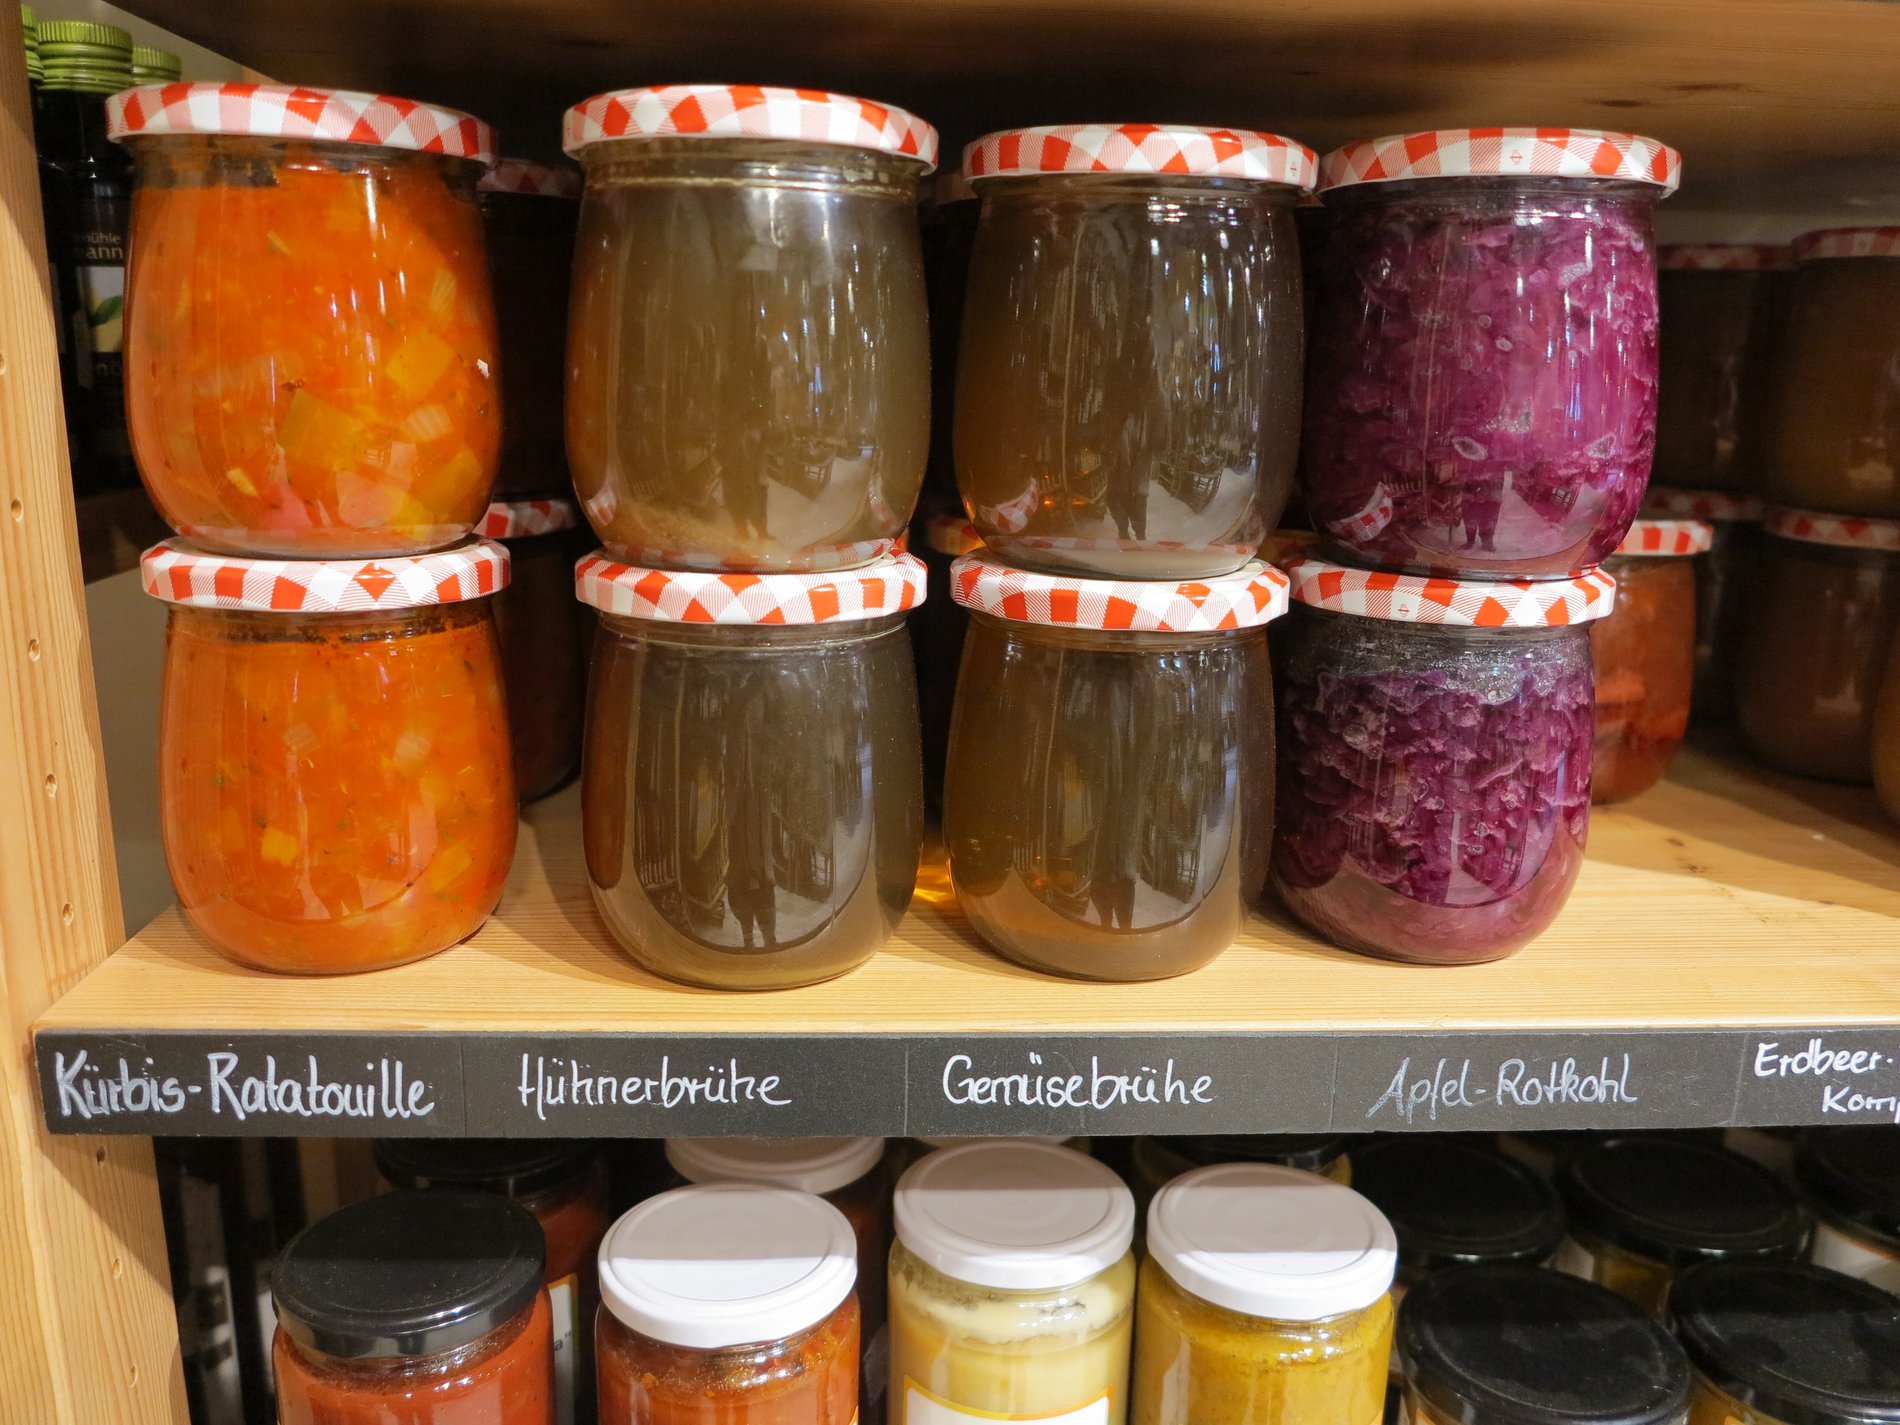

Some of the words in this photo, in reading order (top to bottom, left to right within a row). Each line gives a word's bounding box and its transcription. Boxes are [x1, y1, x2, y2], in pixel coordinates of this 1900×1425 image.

[55, 1049, 435, 1121] Kürbis-Ratatouille
[517, 1053, 792, 1121] Hühnerbrühe
[942, 1052, 1213, 1110] Gemüsebrühe
[1365, 1053, 1638, 1124] Apfel-Rotkohl
